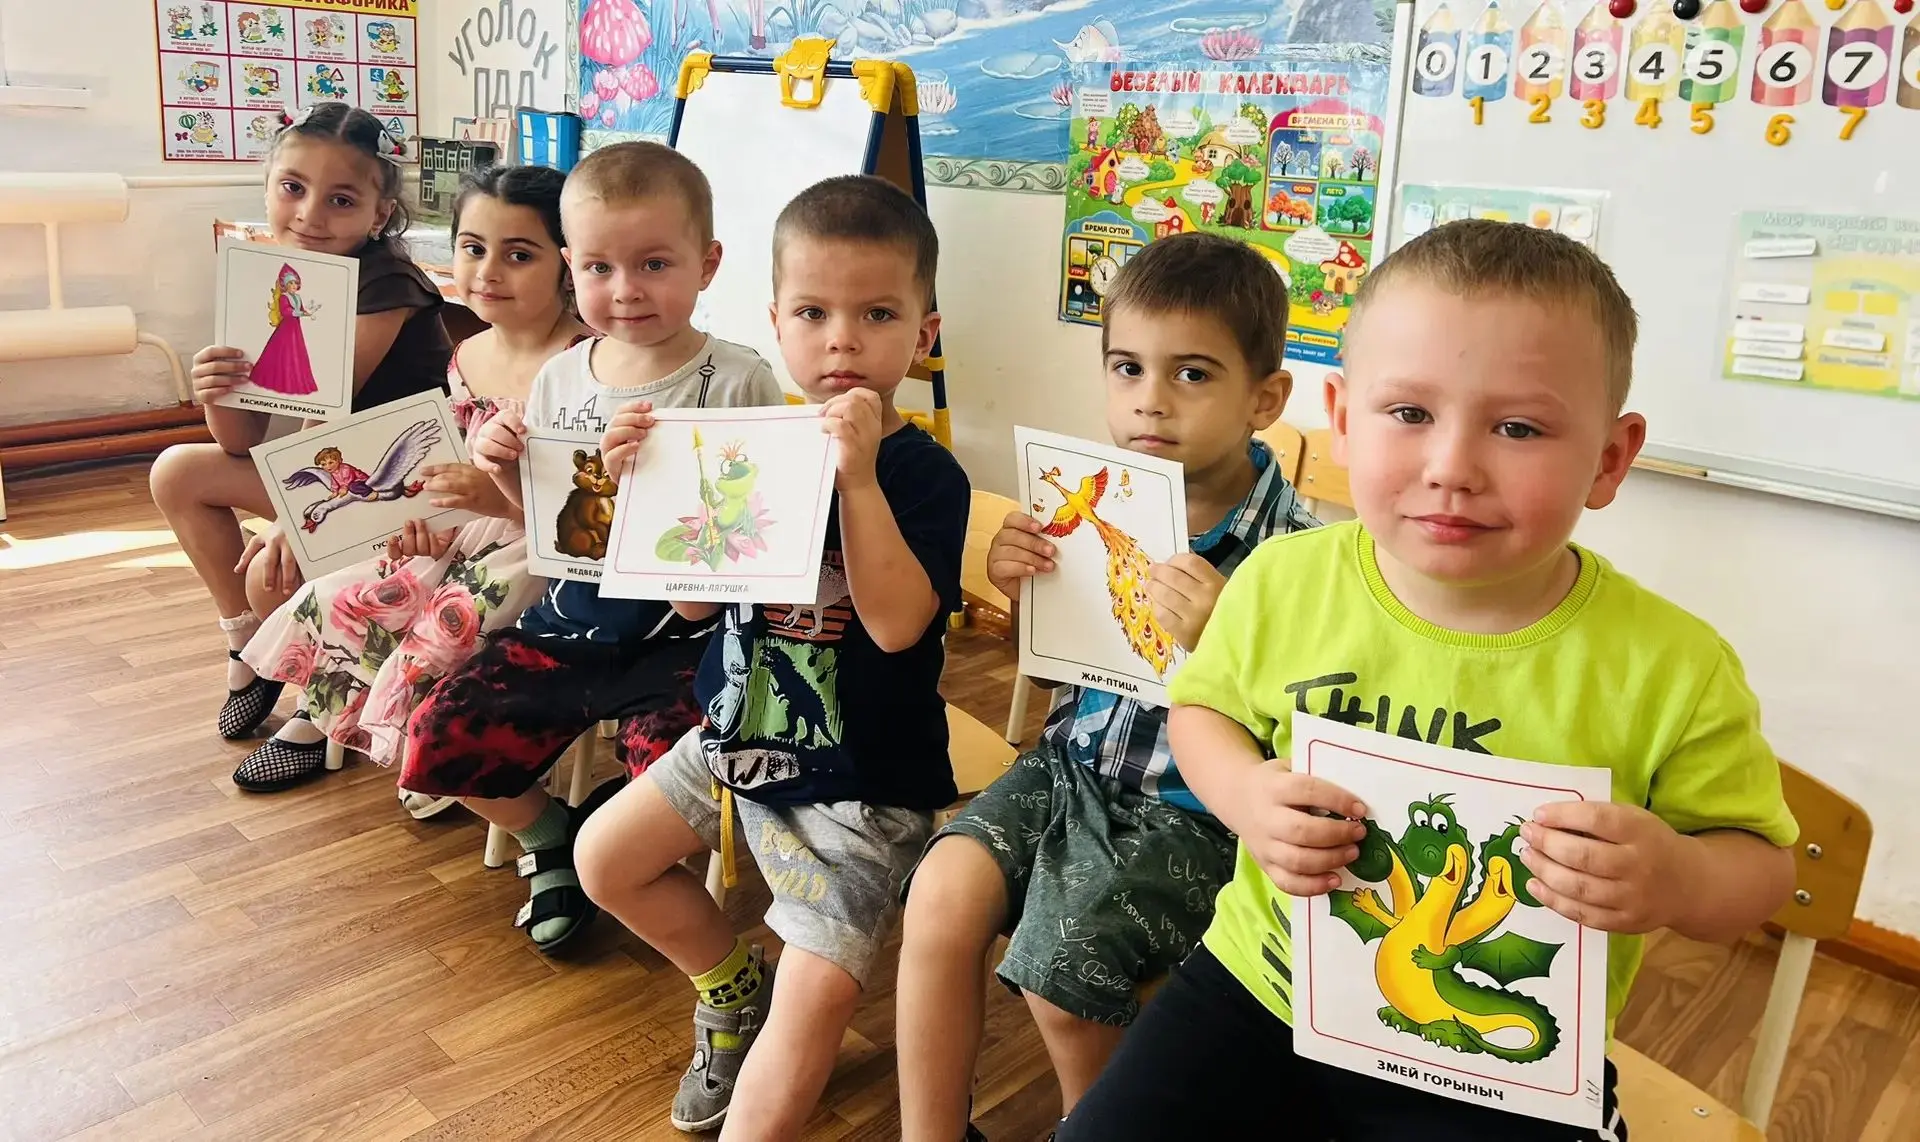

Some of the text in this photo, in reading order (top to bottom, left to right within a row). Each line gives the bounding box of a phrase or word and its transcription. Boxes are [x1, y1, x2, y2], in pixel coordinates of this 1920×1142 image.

[448, 0, 559, 80] УГОЛОК
[1425, 49, 1873, 83] 0 1 2 3 4 5 6 7
[1469, 93, 1867, 146] 1 2 3 4 5 6 7
[1085, 224, 1130, 236] ВРЕМЯ СУТОК
[240, 398, 326, 416] ВАСИЛИСА ПРЕКРАСНАЯ
[665, 582, 749, 593] ЦАРЕВНА-ЛЯГУШКА
[1081, 671, 1139, 693] ЖАР-ПТИЦА
[1377, 1059, 1504, 1101] ЗМЕЙ ГОРЫНЫЧ
